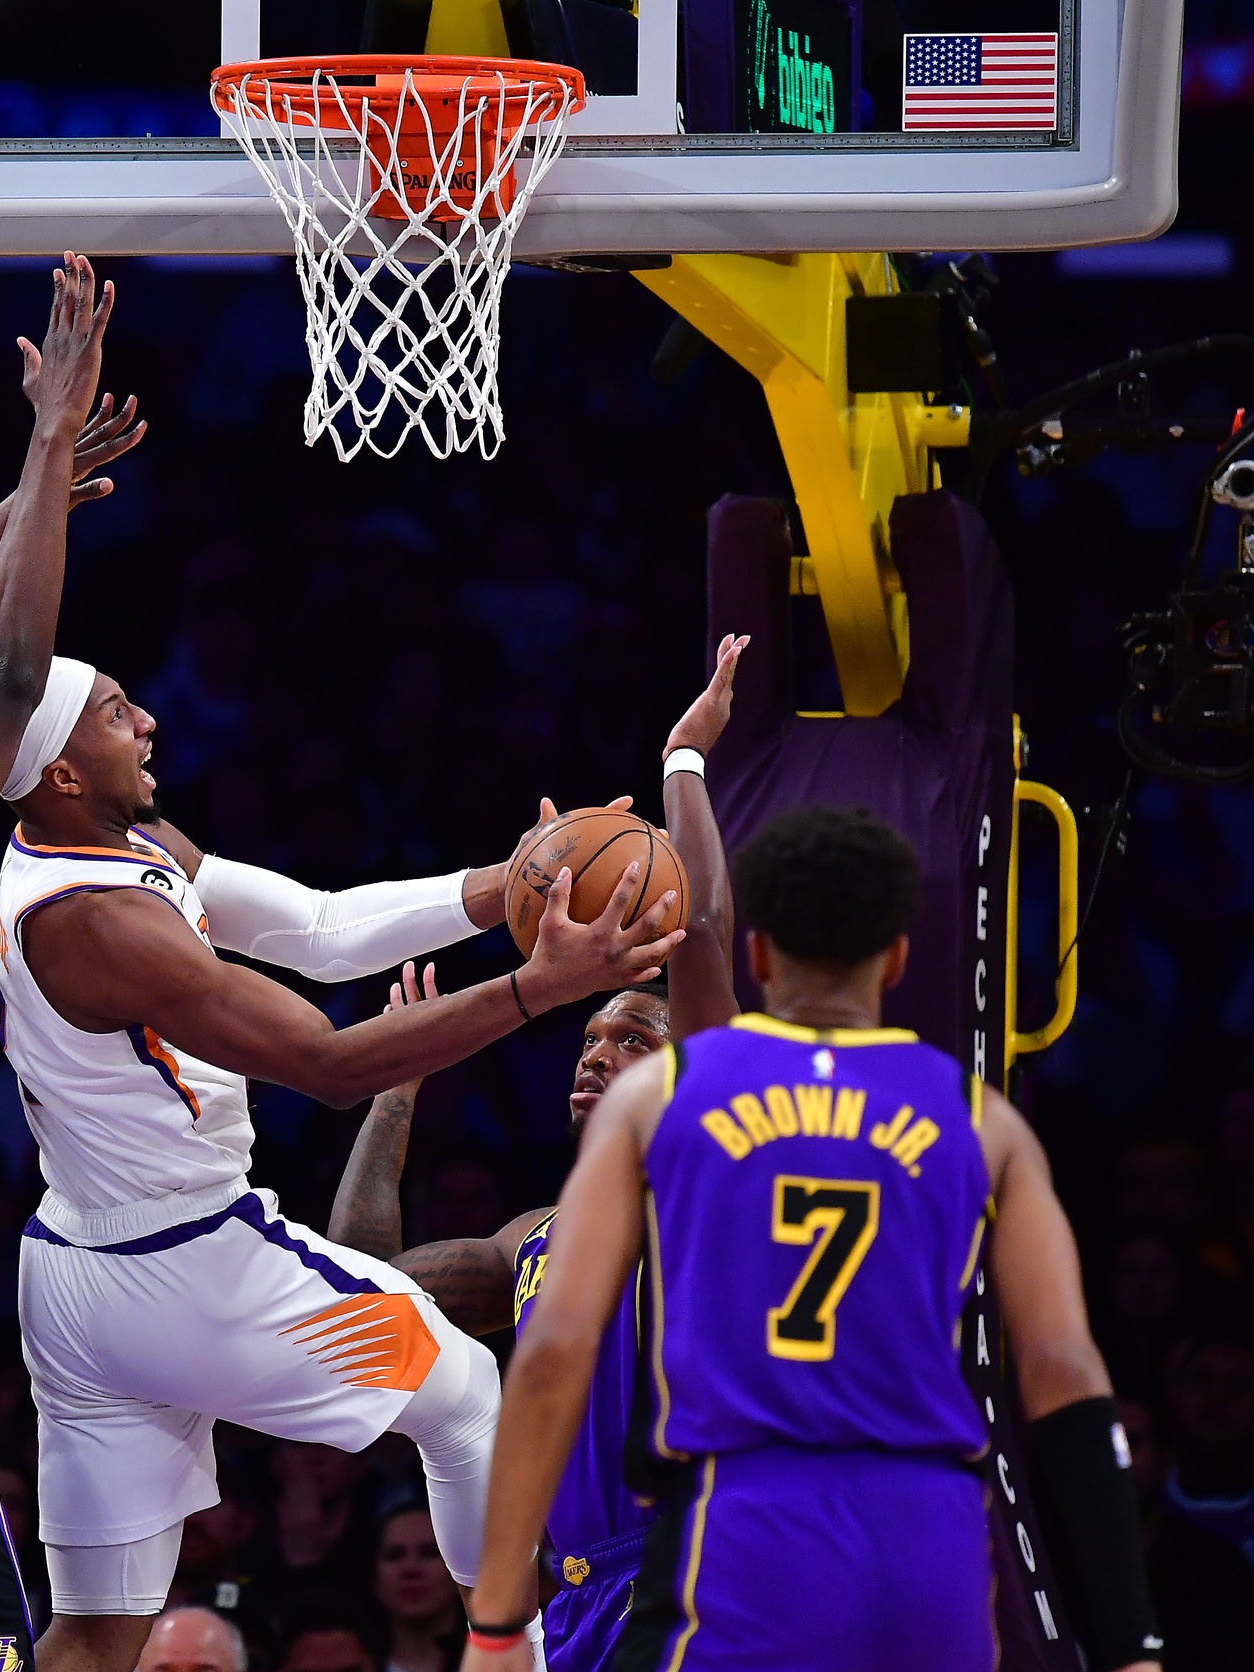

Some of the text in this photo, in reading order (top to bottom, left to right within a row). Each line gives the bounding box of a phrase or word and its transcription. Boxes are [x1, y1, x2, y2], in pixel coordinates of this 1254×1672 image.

[777, 27, 835, 134] bibigo
[389, 171, 476, 192] SPALNG
[700, 1084, 940, 1178] BROWN JR.
[767, 1174, 881, 1362] 7
